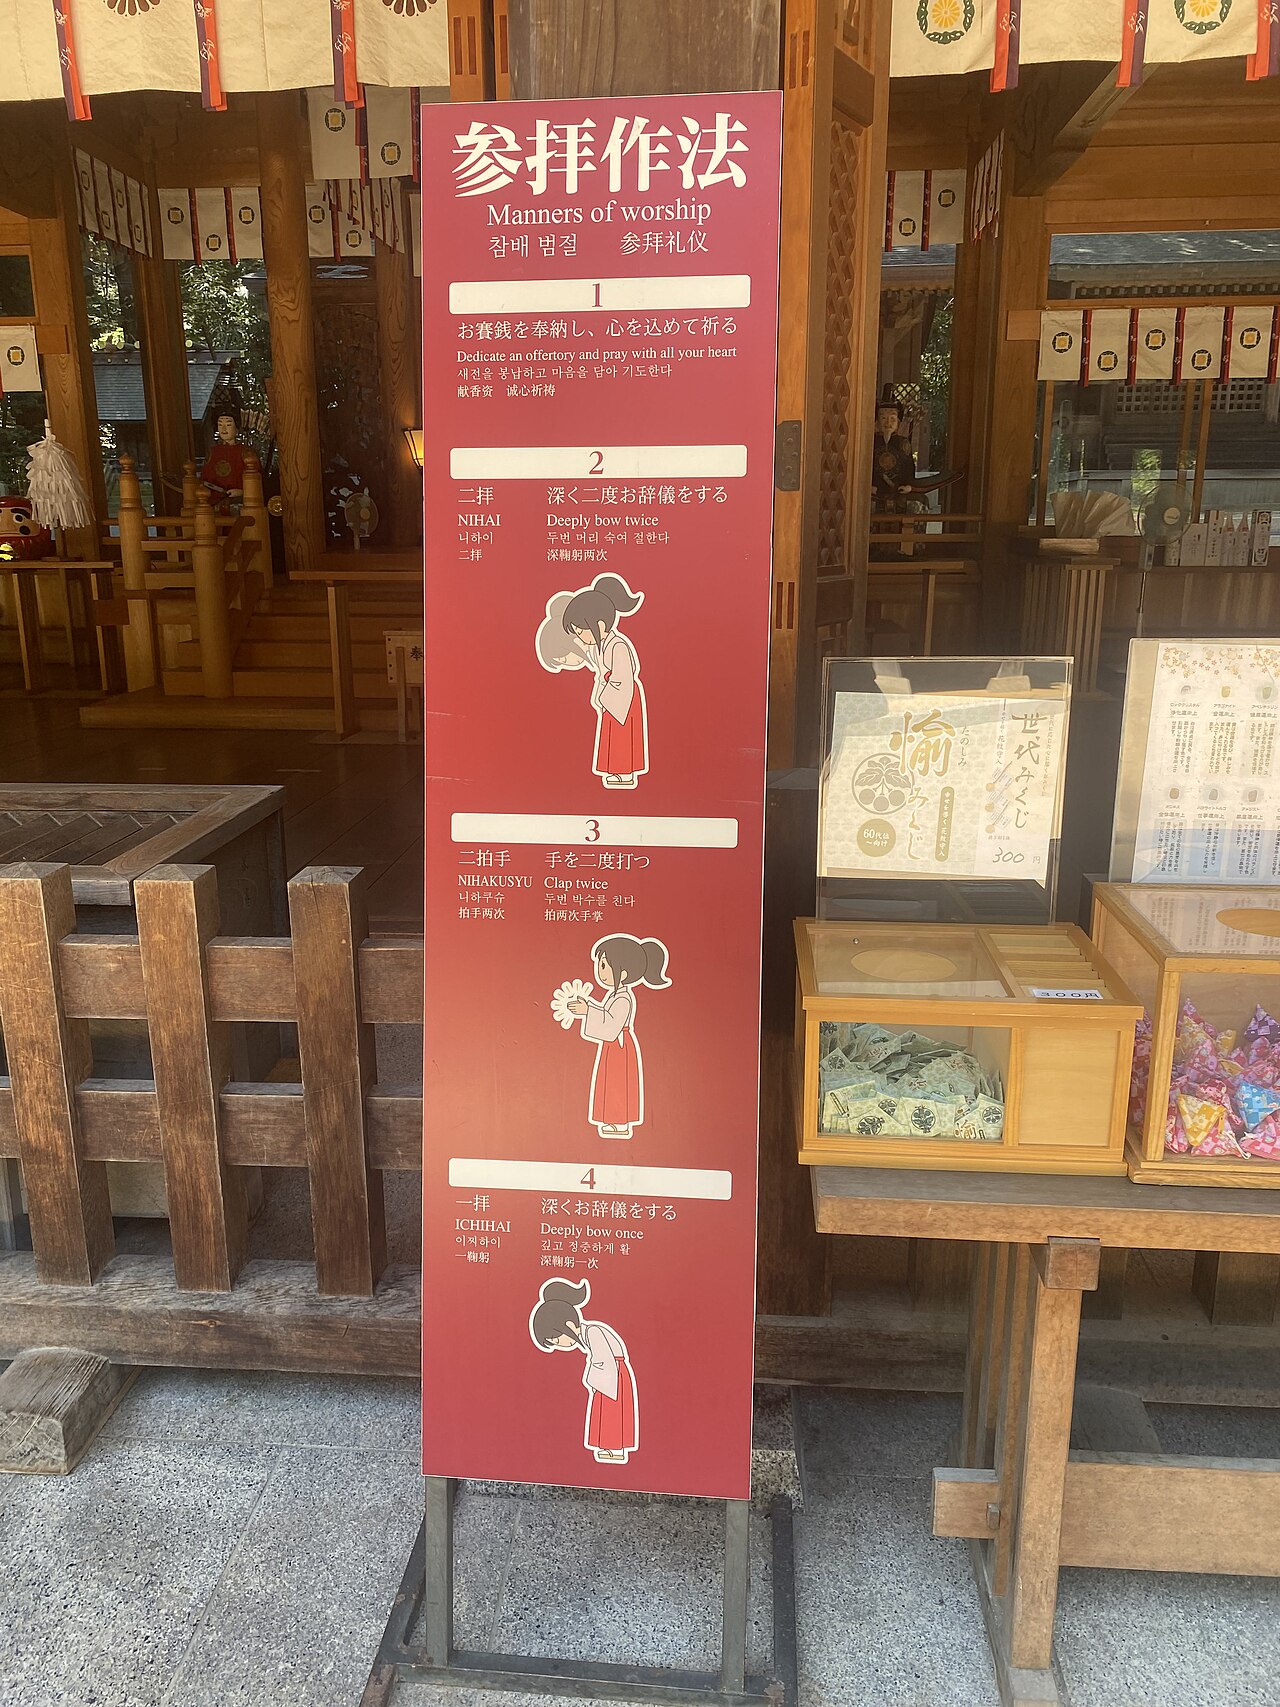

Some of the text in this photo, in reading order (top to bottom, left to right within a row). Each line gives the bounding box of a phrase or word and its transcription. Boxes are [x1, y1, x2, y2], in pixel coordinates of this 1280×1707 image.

[451, 111, 751, 198] 参拝作法
[486, 197, 711, 226] Manners of worship
[488, 233, 577, 259] 참배 범절
[619, 229, 709, 255] 参拜礼仪
[592, 283, 604, 308] 1
[456, 315, 739, 341] お賽銭を奉納し、心を込めて祈る
[456, 345, 737, 364] Dedicate an offertory and pray with all your heart
[457, 363, 673, 381] 새전을 봉납하고 마음을 담아 기도한다
[457, 383, 556, 398] 献香资 诚心祈祷
[588, 450, 605, 475] 2
[458, 486, 494, 506] 二拝
[547, 485, 728, 505] 深く二度お辞儀をする
[457, 513, 501, 527] NIHAI
[546, 513, 659, 530] Deeply bow twice
[458, 531, 493, 545] 니하이
[546, 531, 571, 545] 두번
[575, 531, 599, 545] 머리
[634, 531, 670, 545] 절한다
[458, 548, 483, 562] 二拝
[546, 548, 608, 562] 深鞠躬两次
[889, 708, 957, 777] 愉
[957, 725, 971, 767] たのしみ
[1011, 712, 1048, 829] 世代みくじ
[584, 819, 601, 842] 3
[907, 786, 930, 860] みくじ
[458, 849, 511, 868] 二拍手
[544, 851, 650, 871] 手を二度打つ
[992, 847, 1025, 864] 300
[457, 874, 533, 888] NIHAKUSYU
[543, 876, 609, 892] Clap twice
[458, 890, 505, 904] 니하쿠슈
[544, 893, 636, 907] 두번 박수를 친다
[458, 906, 505, 920] 拍手两次
[580, 1167, 597, 1190] 4
[455, 1194, 491, 1212] 一拝
[540, 1197, 678, 1222] 深くお辞儀をする
[455, 1218, 511, 1233] ICHIHAI
[540, 1222, 644, 1240] Deeply bow once
[568, 1240, 614, 1255] 정중하게
[540, 1254, 599, 1269] 深鞠躬一次
